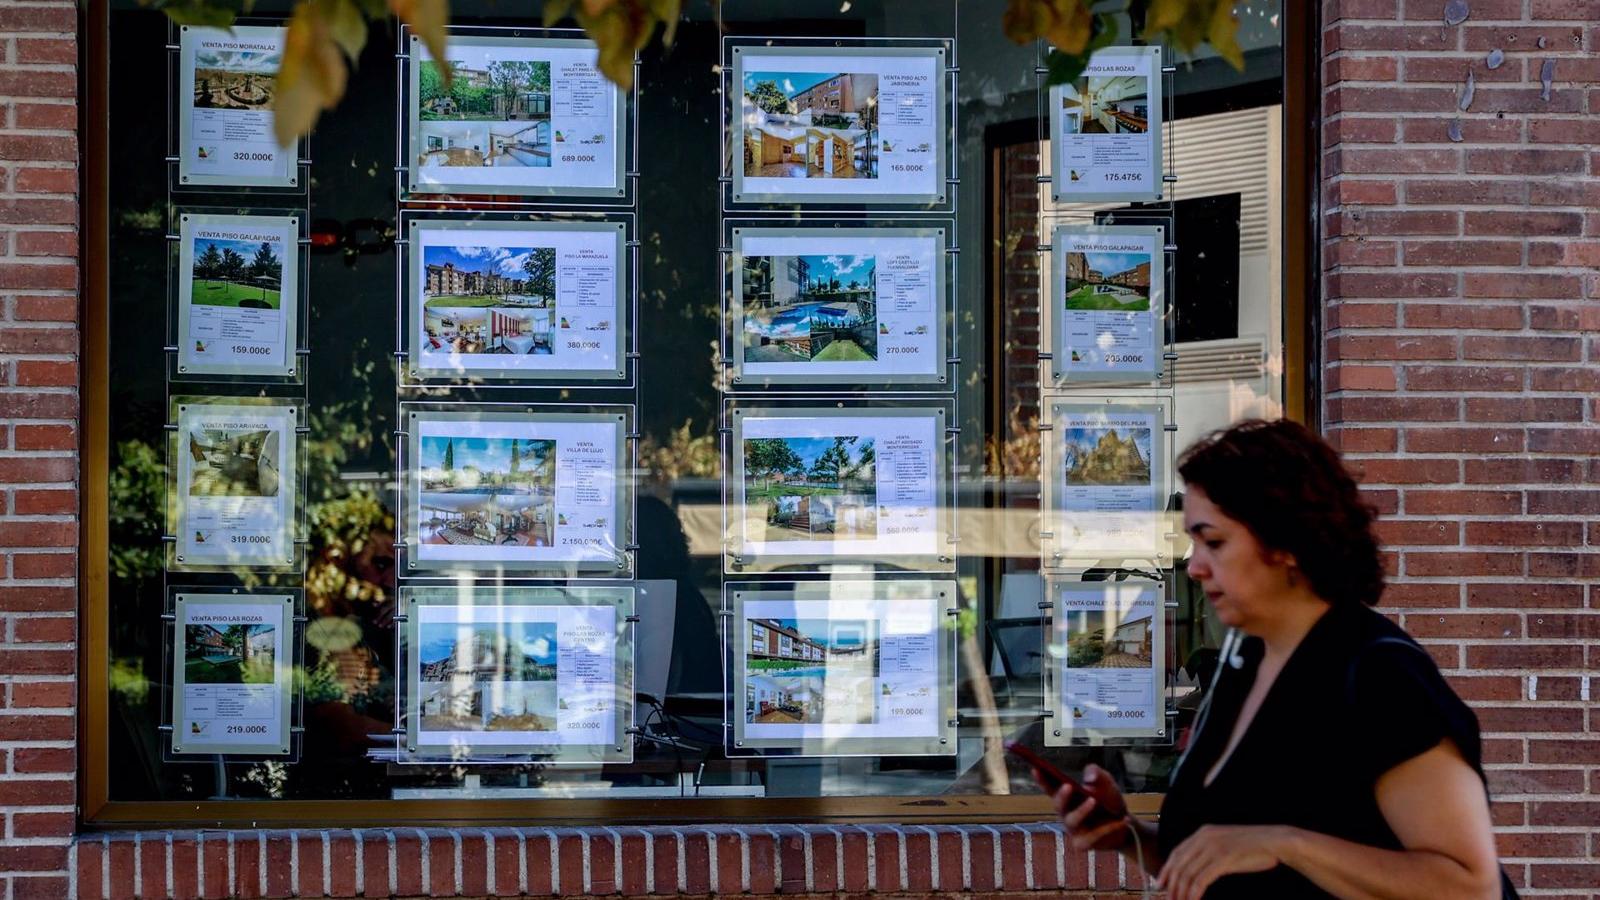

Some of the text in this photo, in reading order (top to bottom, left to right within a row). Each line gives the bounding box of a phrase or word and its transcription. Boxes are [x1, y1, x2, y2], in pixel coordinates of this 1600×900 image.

[234, 152, 273, 161] 320.000€
[240, 234, 280, 242] GALAPAGAR
[232, 346, 271, 355] 159.000€
